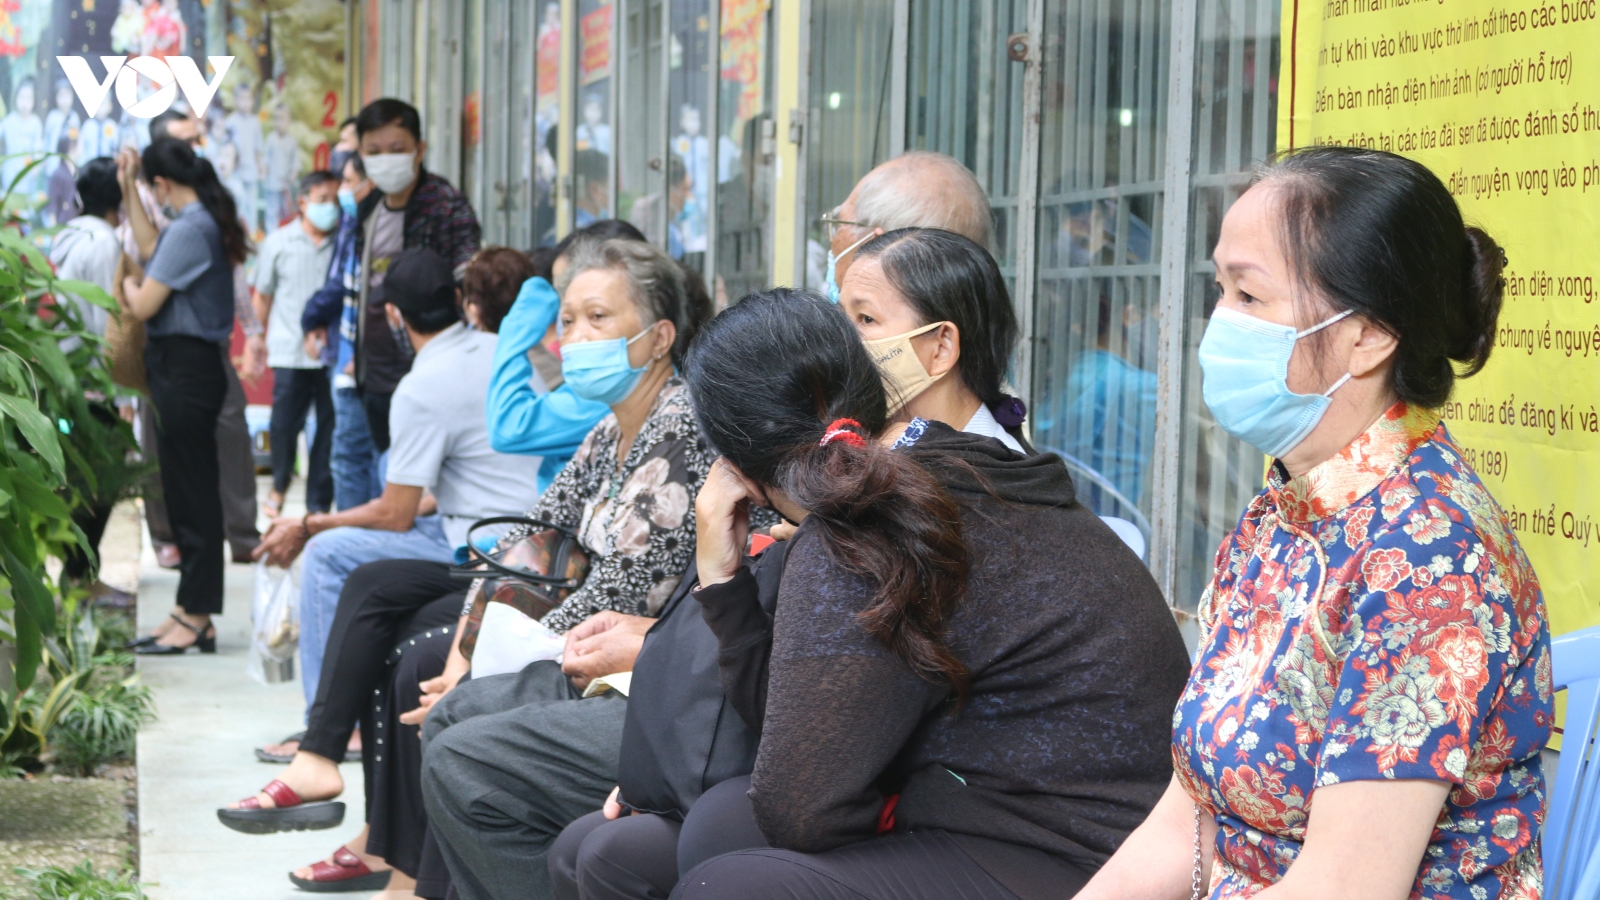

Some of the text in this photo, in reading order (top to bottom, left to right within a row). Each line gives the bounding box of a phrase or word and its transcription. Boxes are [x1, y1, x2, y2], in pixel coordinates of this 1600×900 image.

[1331, 43, 1343, 68] tự
[1346, 37, 1367, 61] khi
[1371, 33, 1396, 58] vào
[1398, 30, 1419, 54] khu
[1421, 27, 1443, 54] vực
[1482, 7, 1497, 38] cốt
[1499, 8, 1527, 34] theo
[1531, 0, 1557, 28] các
[1338, 86, 1362, 110] bàn
[1367, 81, 1399, 110] nhận
[1402, 78, 1427, 106] diện
[1430, 73, 1451, 99] hình
[1453, 68, 1472, 95] ảnh
[1491, 58, 1523, 94] người
[1527, 51, 1546, 82] hỗ
[1550, 51, 1573, 85] trợ)
[1397, 127, 1418, 152] các
[1420, 125, 1437, 149] tòa
[1439, 122, 1456, 147] đài
[1459, 124, 1475, 146] sen
[1476, 117, 1487, 143] đã
[1490, 116, 1520, 145] được
[1524, 109, 1558, 137] đánh
[1561, 102, 1579, 134] số
[1471, 166, 1511, 200] nguyện
[1516, 169, 1549, 196] vọng
[1553, 160, 1577, 188] vào
[1529, 270, 1553, 302] diện
[1557, 276, 1598, 304] xong,
[1499, 322, 1534, 356] chung
[1468, 397, 1495, 424] chùa
[1498, 393, 1516, 426] để
[1520, 401, 1556, 436] đăng
[1560, 403, 1575, 431] kí
[1579, 405, 1599, 433] và
[1532, 503, 1556, 537] thể
[1561, 511, 1592, 548] Quý
